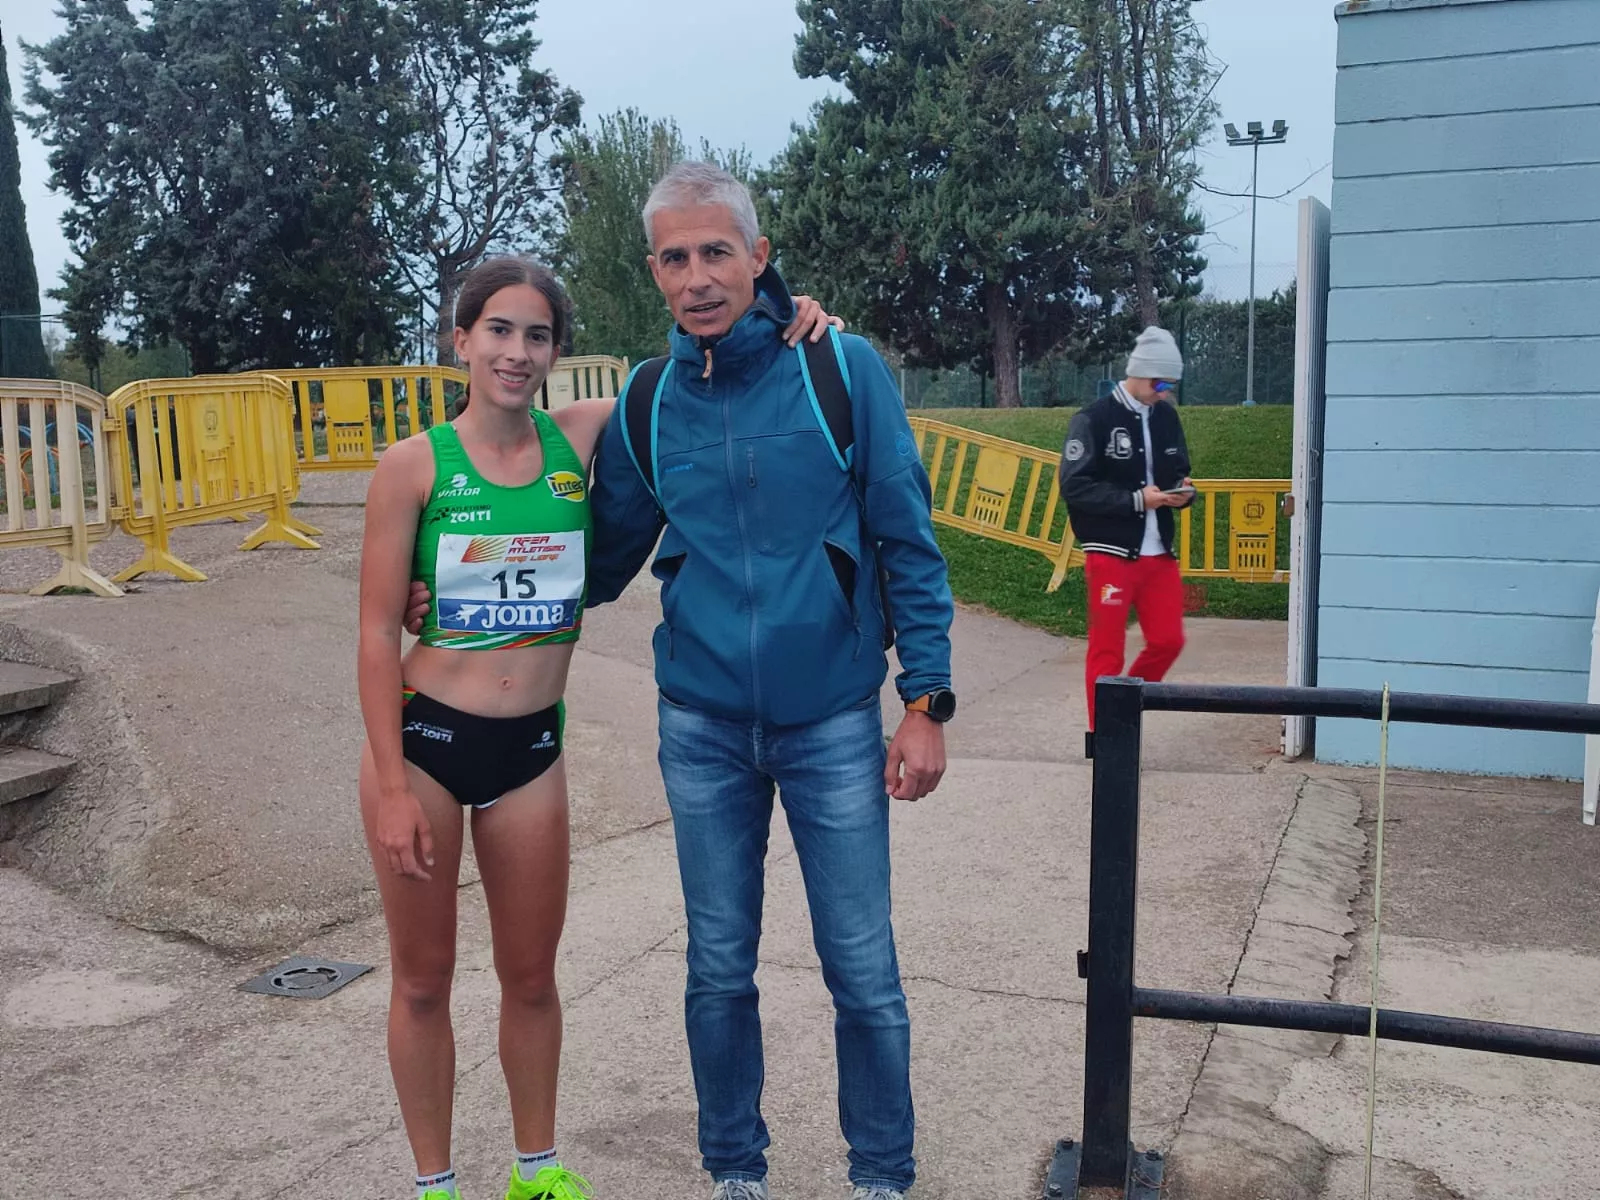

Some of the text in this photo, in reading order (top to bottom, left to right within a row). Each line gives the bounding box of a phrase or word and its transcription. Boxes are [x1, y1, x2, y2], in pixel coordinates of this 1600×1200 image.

[450, 510, 492, 524] ZOITI
[491, 569, 537, 599] 15
[421, 727, 453, 743] ZOITI
